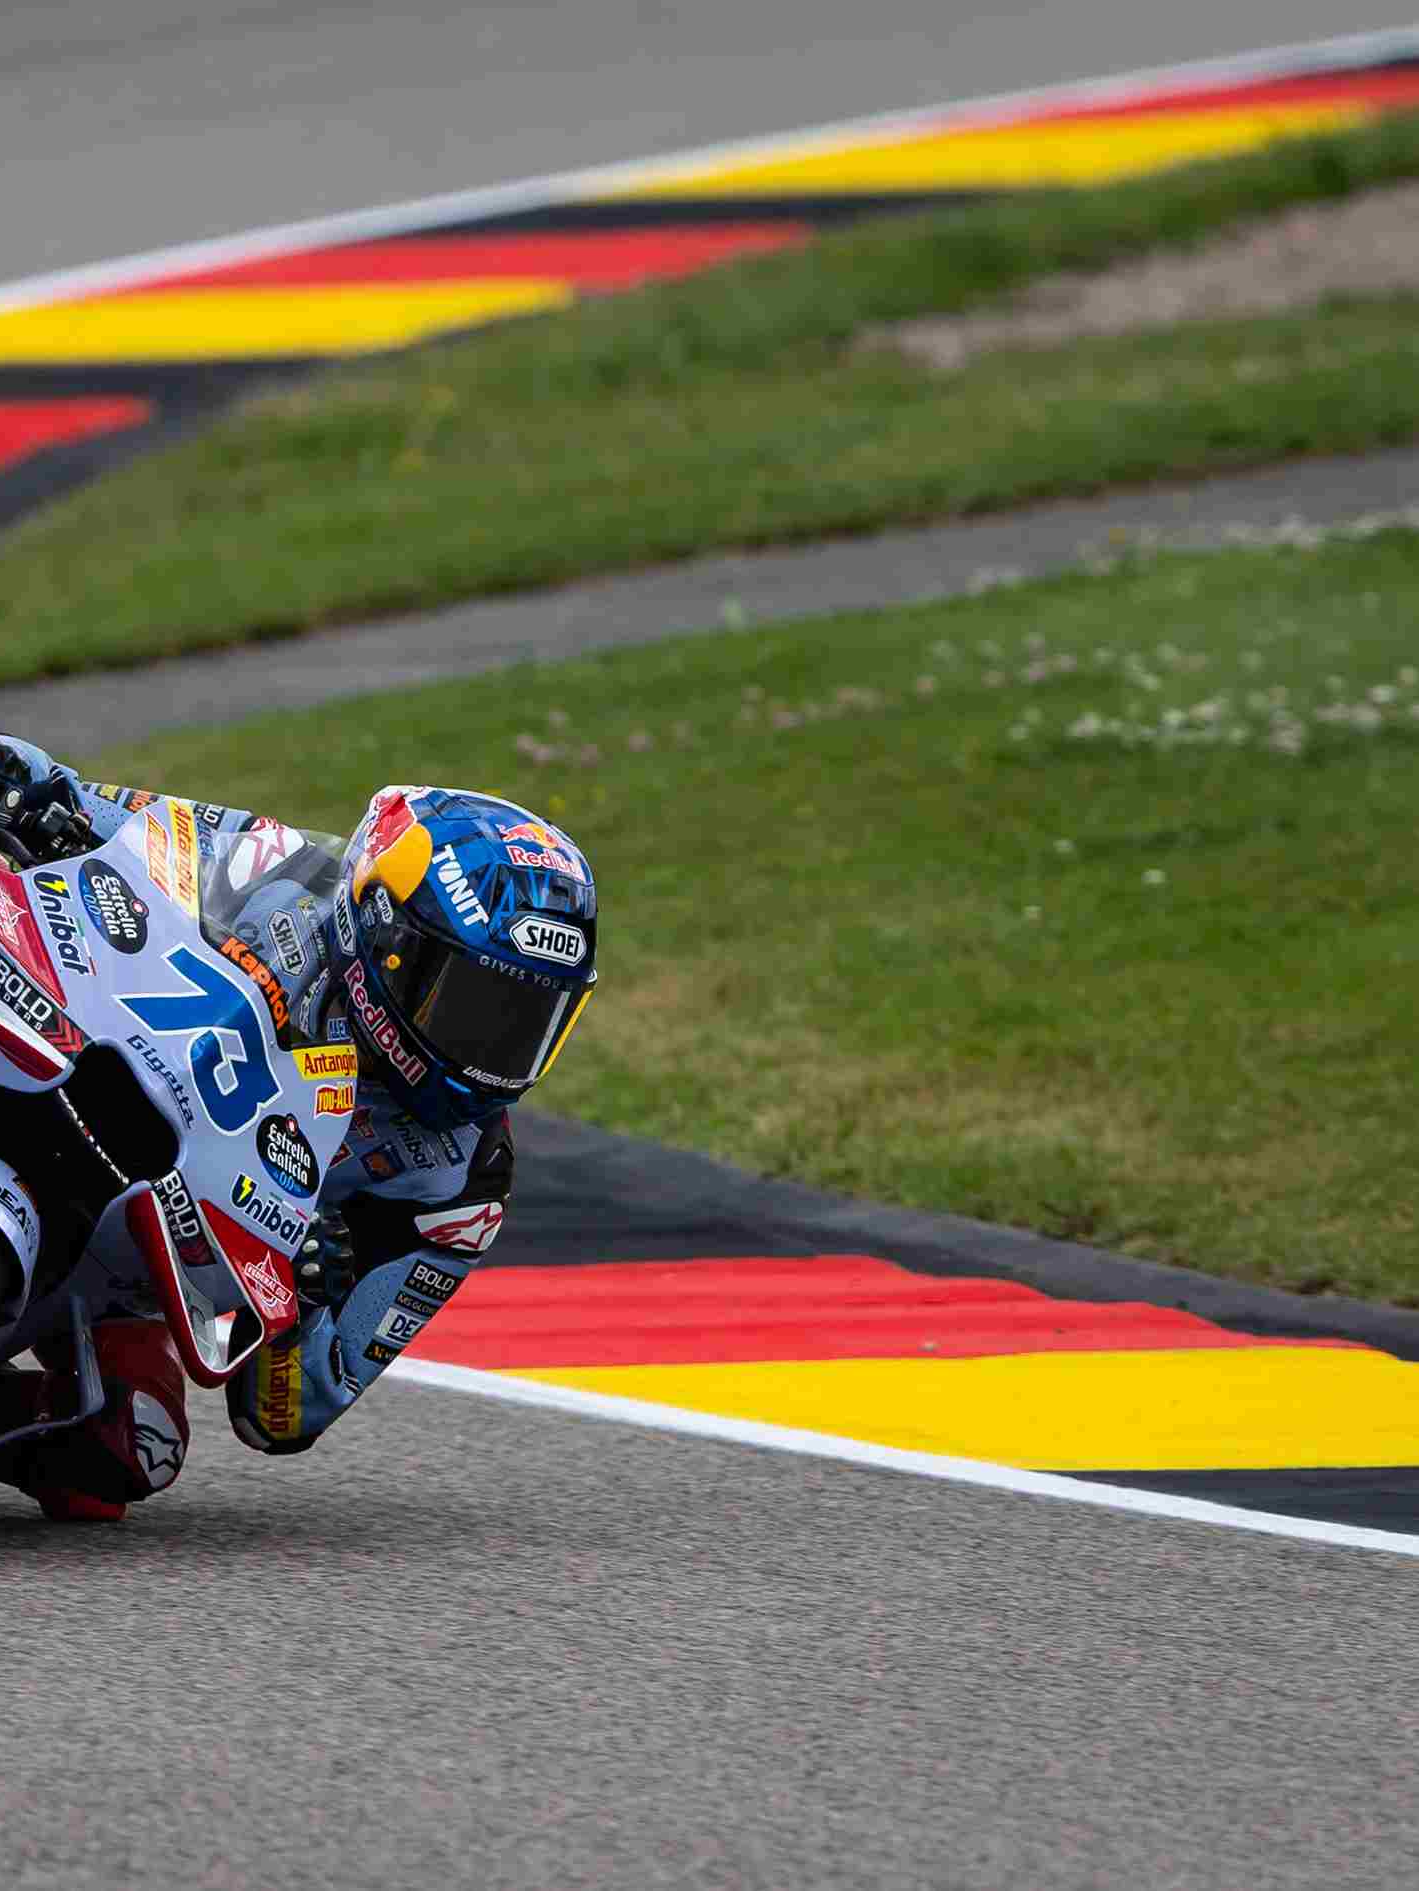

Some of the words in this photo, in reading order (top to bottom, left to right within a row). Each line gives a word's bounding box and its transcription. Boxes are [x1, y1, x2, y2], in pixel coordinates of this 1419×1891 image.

[91, 875, 121, 936] Galicia
[105, 873, 138, 939] Estrella
[432, 844, 490, 926] TONIT
[33, 871, 90, 975] Unibat
[524, 925, 580, 958] SHOEI
[220, 936, 289, 1030] Kapriol
[479, 955, 525, 981] GIVES
[112, 943, 283, 1135] 73
[267, 1142, 309, 1186] Galicia
[268, 1123, 311, 1170] Estrella
[162, 1170, 200, 1238] BOLD
[231, 1173, 305, 1246] Unibat
[413, 1264, 455, 1291] BOLD
